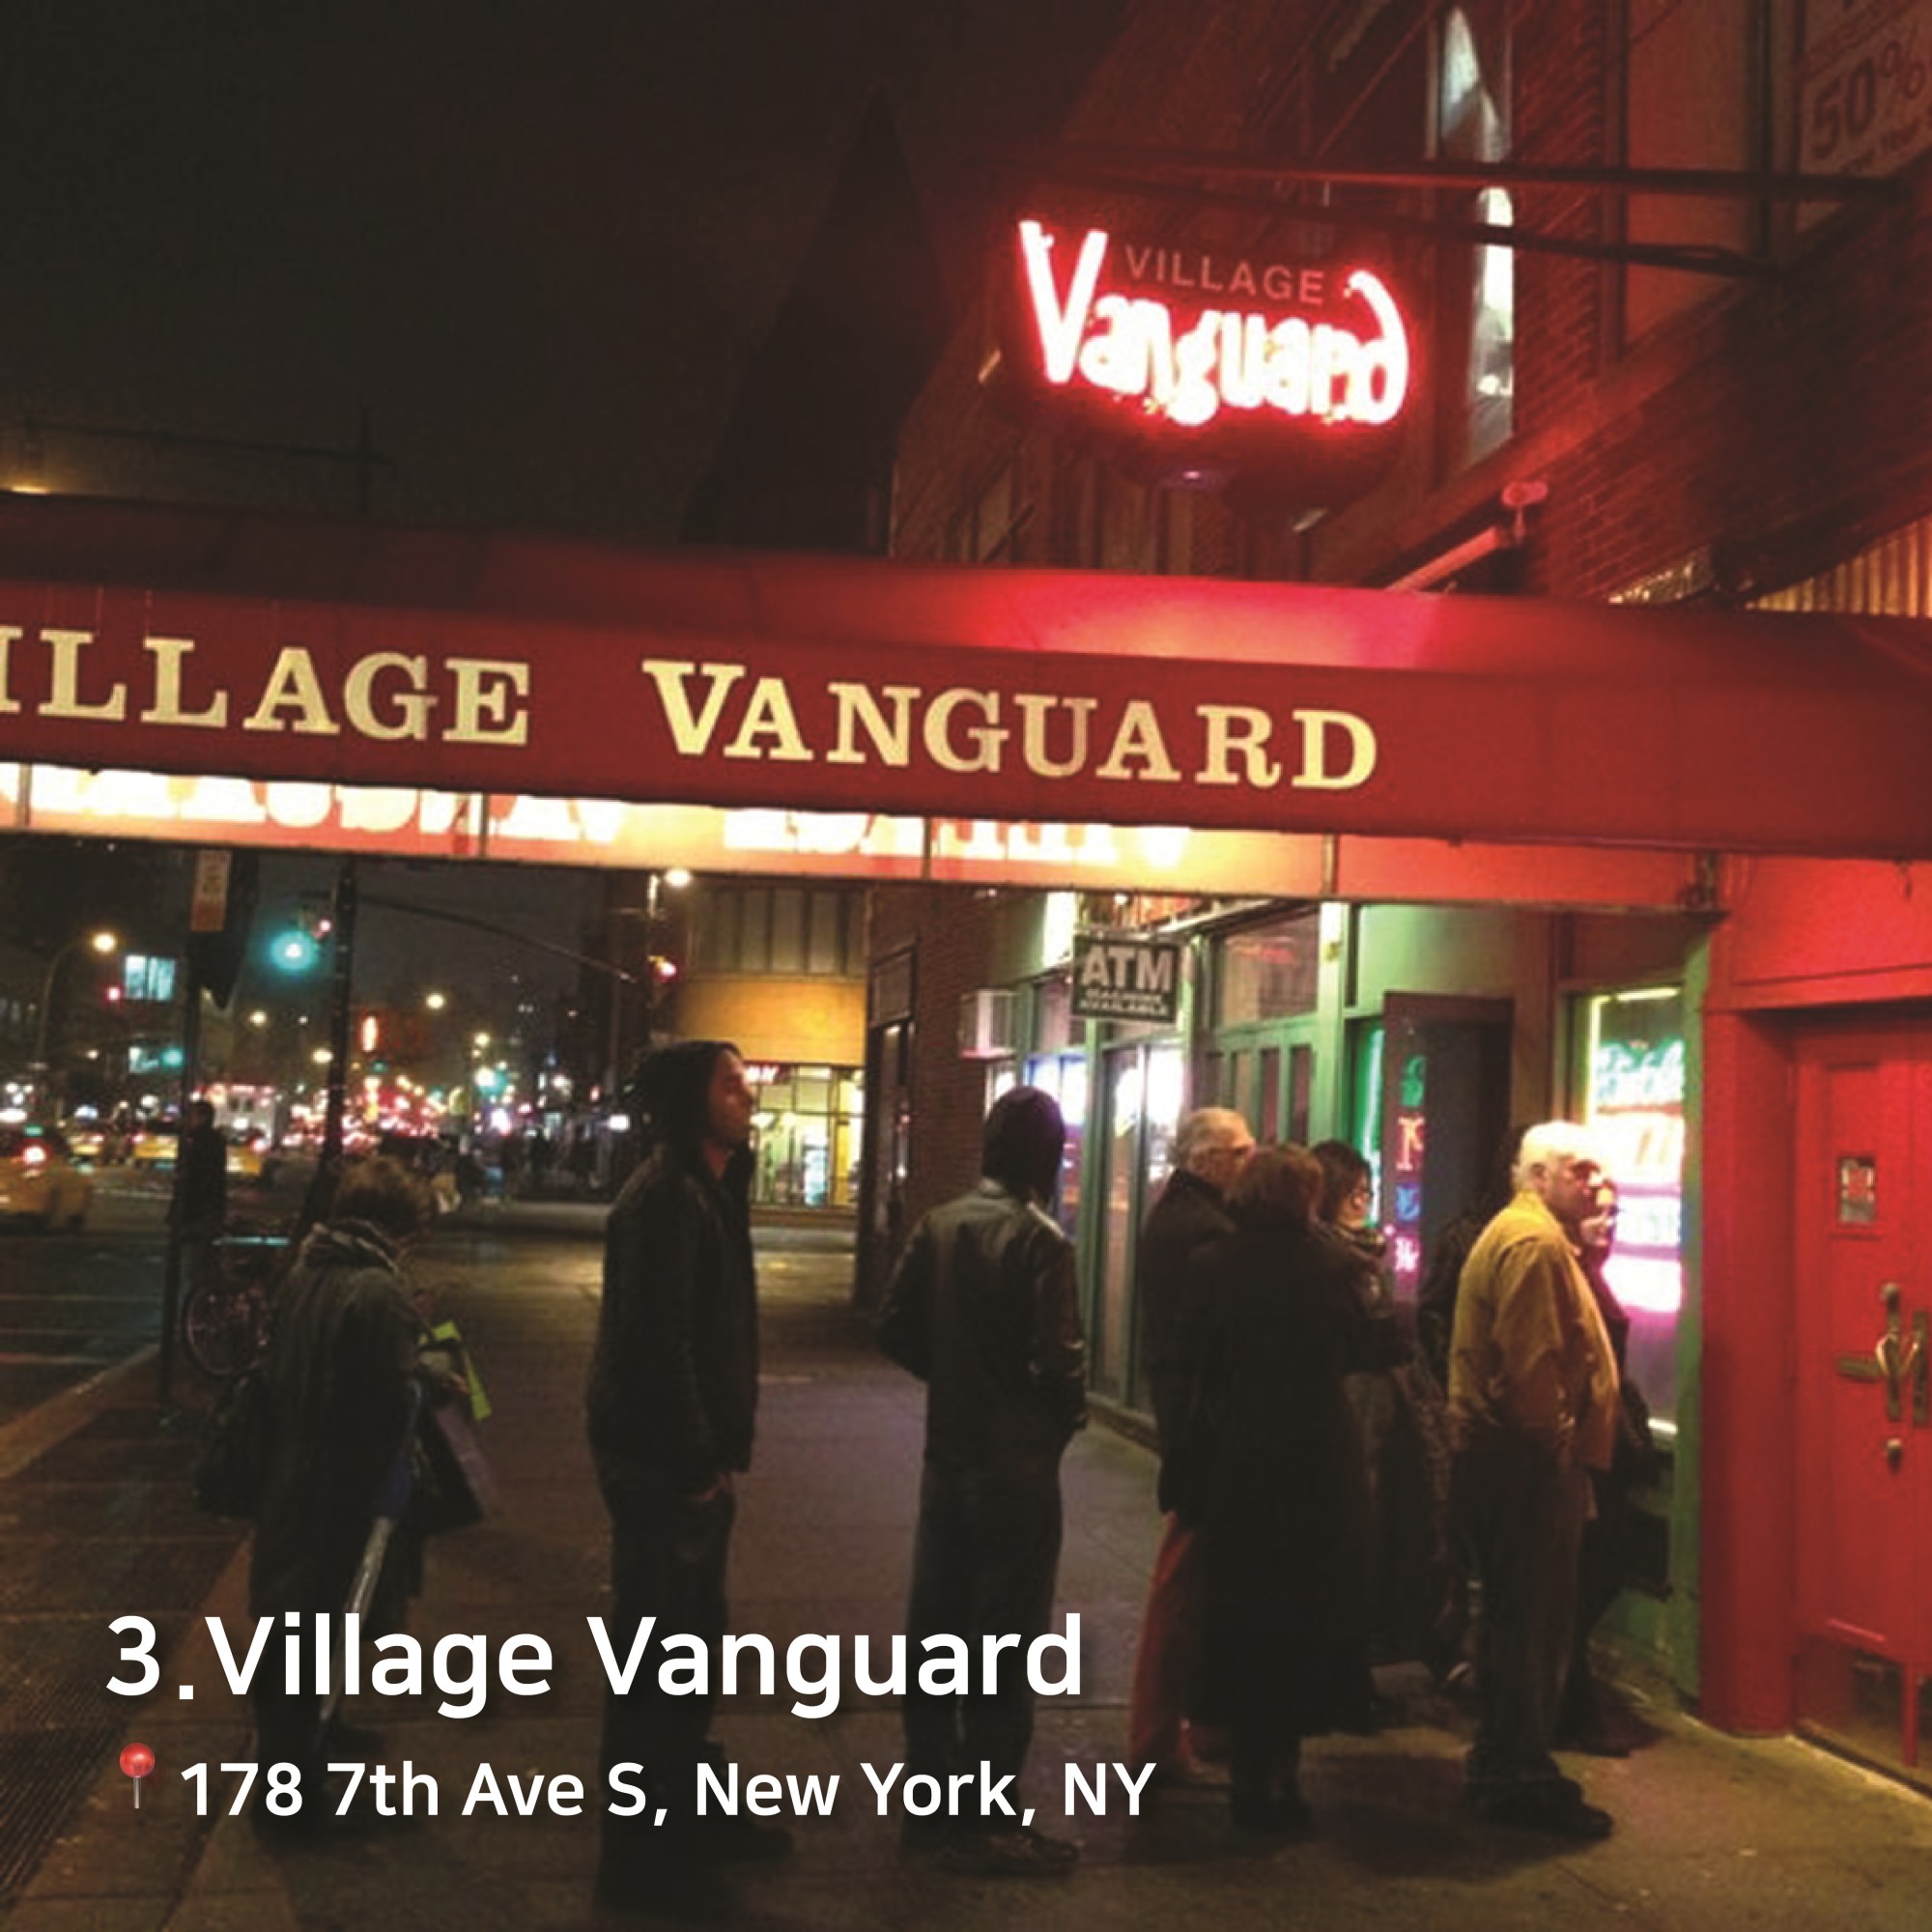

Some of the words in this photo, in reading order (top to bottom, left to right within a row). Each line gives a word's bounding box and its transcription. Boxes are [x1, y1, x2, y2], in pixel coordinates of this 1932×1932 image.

[1125, 243, 1324, 305] VILLAGE
[1018, 219, 1409, 427] Vanguard
[641, 659, 1378, 790] VANGUARD
[1079, 944, 1174, 994] ATM
